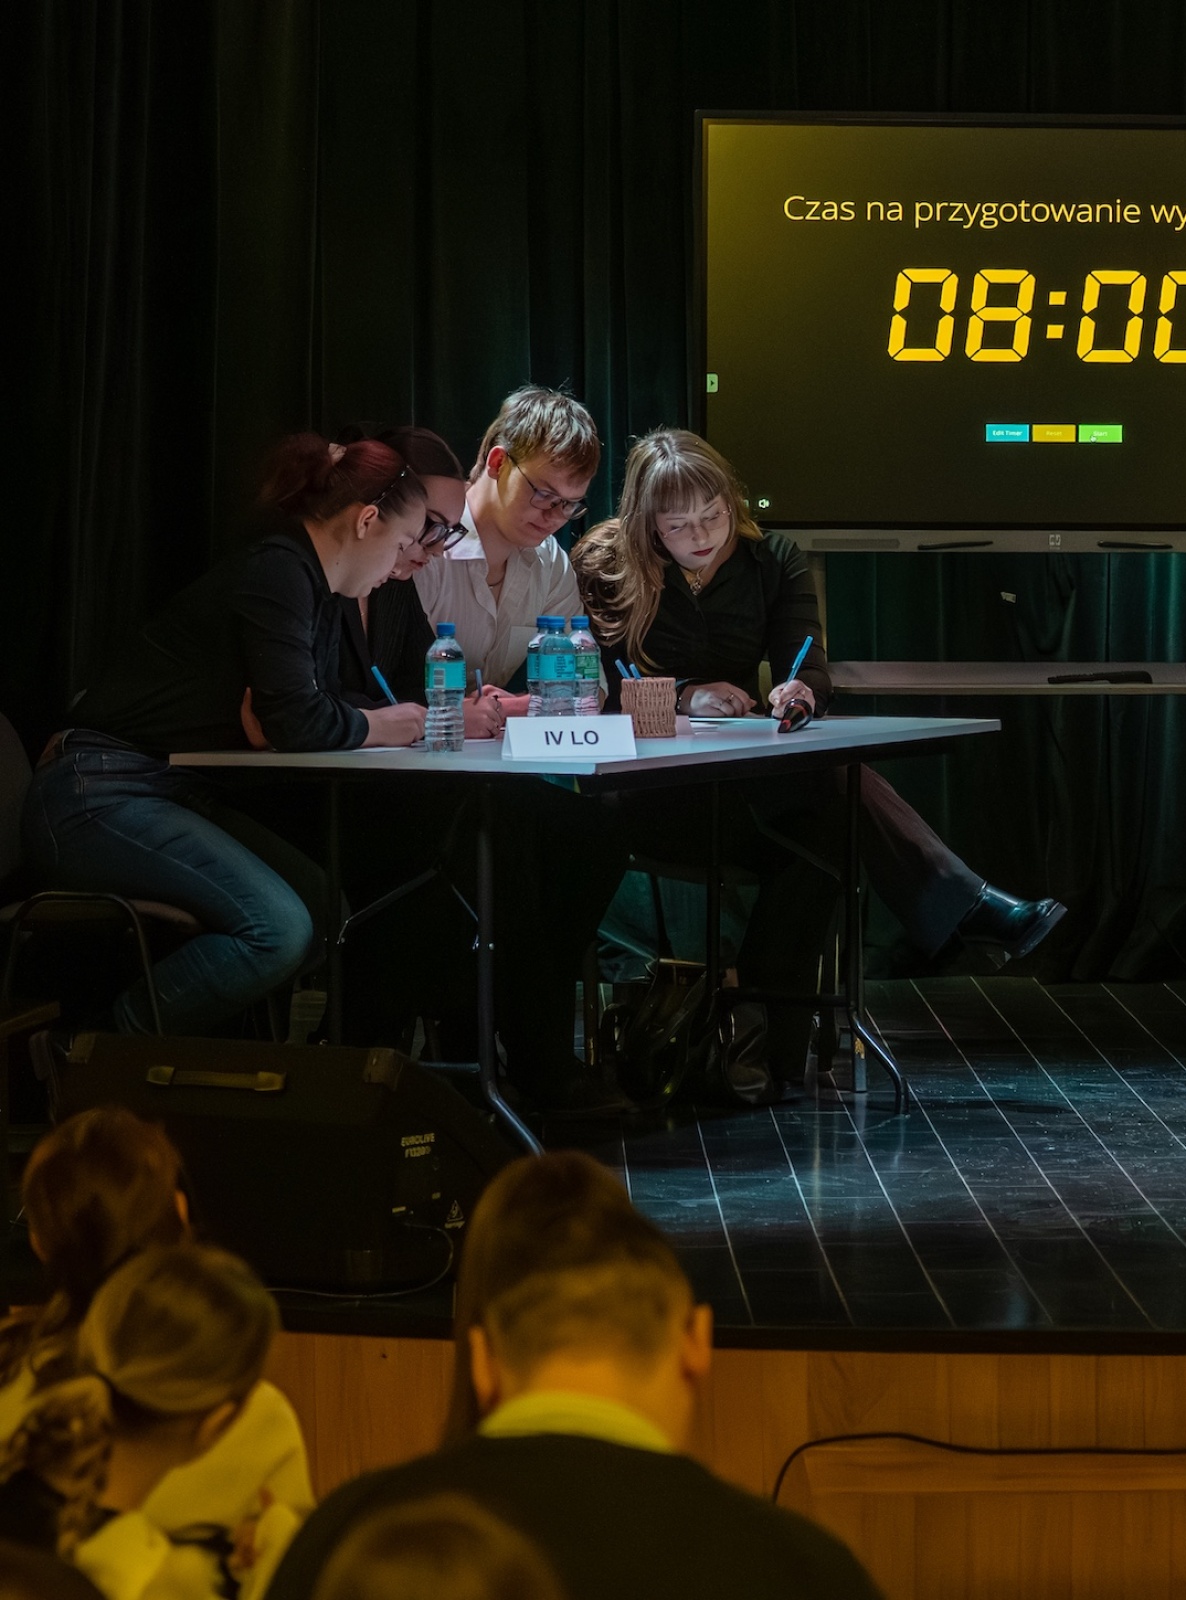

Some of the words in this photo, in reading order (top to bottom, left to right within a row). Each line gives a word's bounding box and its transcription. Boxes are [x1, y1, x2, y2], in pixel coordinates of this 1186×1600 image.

[783, 195, 856, 222] Czas
[866, 201, 903, 222] na
[914, 198, 1141, 231] przygotowanie
[544, 730, 564, 746] IV
[570, 730, 600, 746] LO
